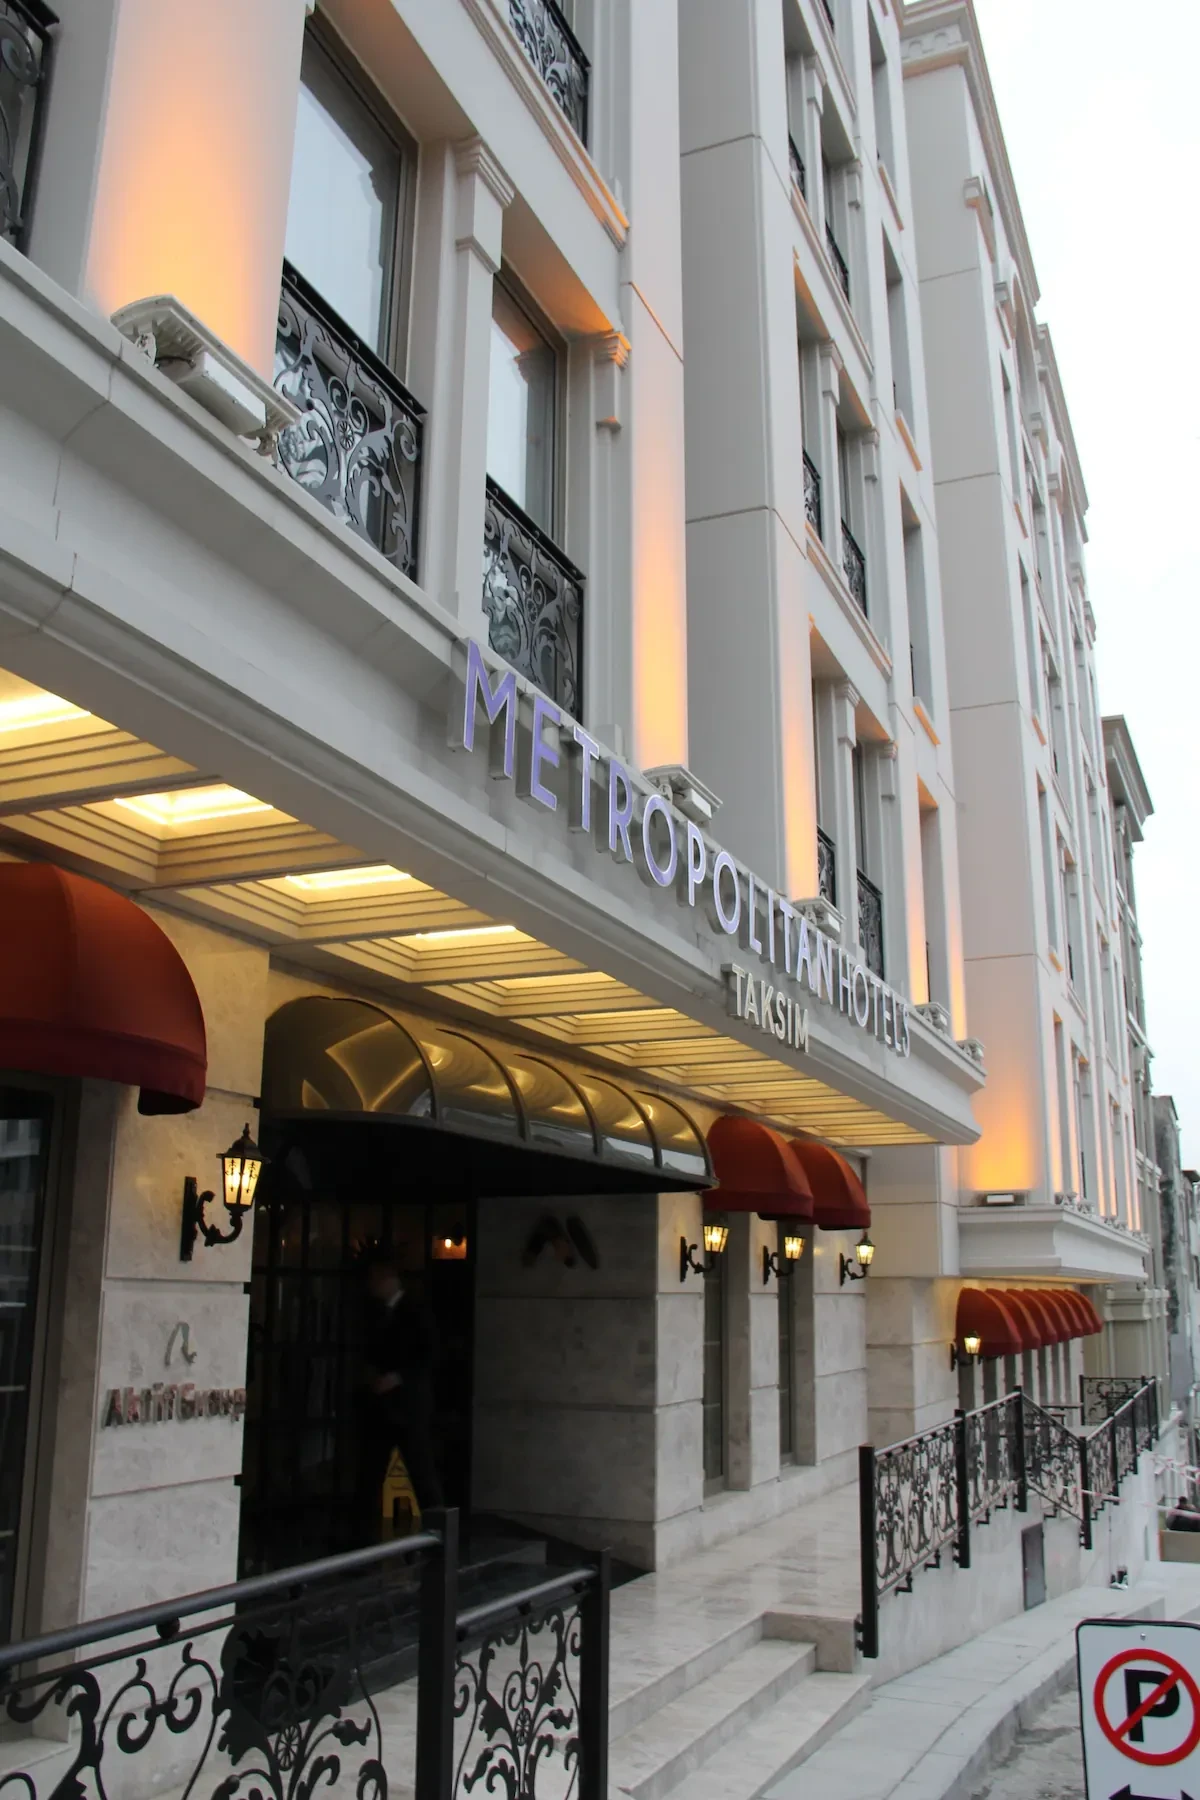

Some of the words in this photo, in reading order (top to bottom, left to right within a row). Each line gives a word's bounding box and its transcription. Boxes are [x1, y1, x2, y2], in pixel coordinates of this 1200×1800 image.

[464, 639, 834, 1005] METROPOLITAN
[838, 948, 910, 1058] HOTELS
[732, 963, 809, 1053] TAKSIM
[1124, 1668, 1180, 1742] P
